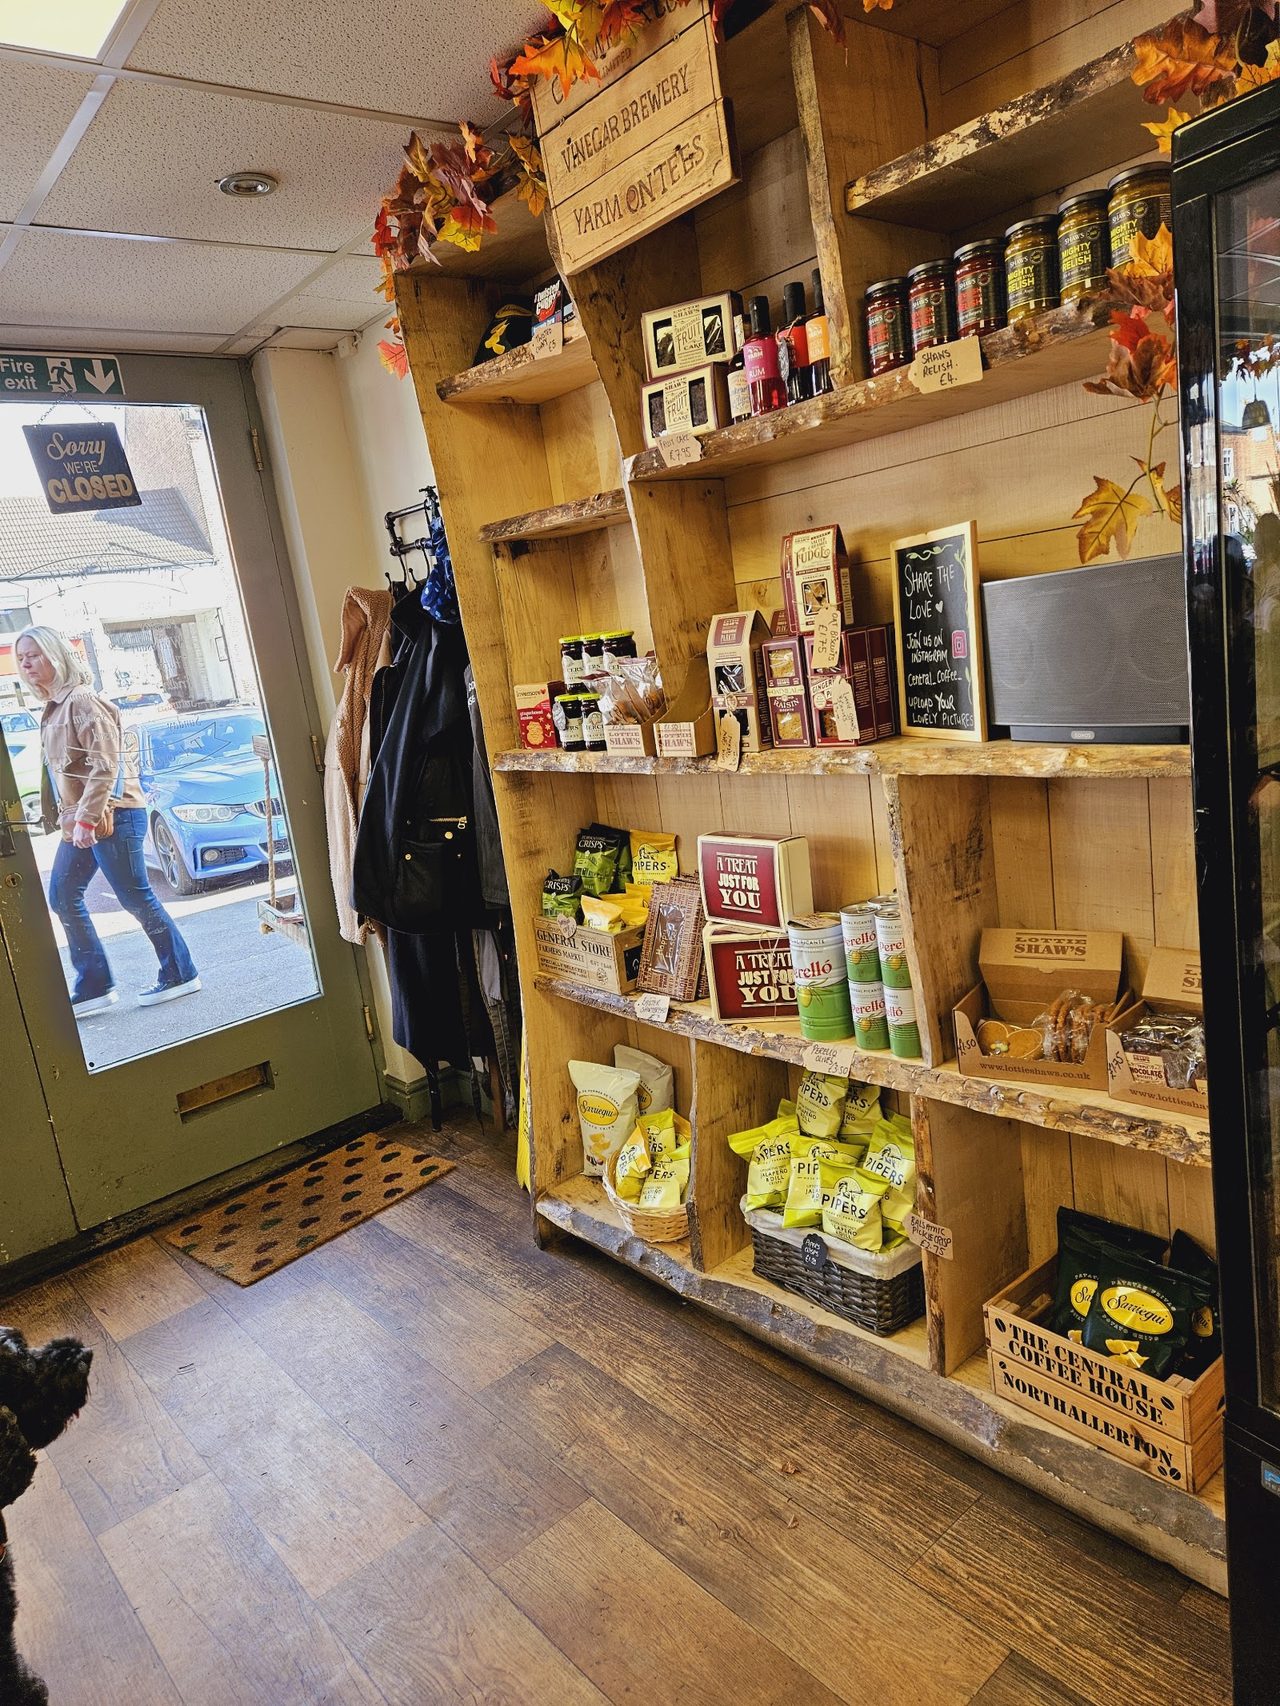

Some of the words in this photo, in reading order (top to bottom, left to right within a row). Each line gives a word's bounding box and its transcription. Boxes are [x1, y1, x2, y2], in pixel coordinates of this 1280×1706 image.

[561, 112, 622, 173] VINEGAR
[622, 63, 690, 134] BREWERY
[572, 194, 623, 235] YARM
[625, 173, 655, 214] ON
[655, 135, 704, 195] TEES
[1110, 219, 1137, 237] MIGHTY
[1062, 242, 1091, 259] MIGHTY
[1062, 254, 1092, 272] RELISH
[1007, 266, 1034, 280] MIGHTY
[1008, 277, 1035, 293] RELISH
[673, 309, 700, 319] SHAW'S
[675, 321, 702, 352] FRUIT
[684, 342, 703, 351] CAKE
[0, 358, 35, 374] Fire
[749, 368, 765, 377] RUM
[5, 376, 38, 390] exit
[666, 394, 688, 423] FRUIT
[47, 432, 107, 465] Sorry
[659, 439, 675, 451] FRUIT
[63, 460, 100, 474] WE'RE
[47, 474, 133, 503] CLOSED
[794, 546, 830, 570] FUDGE
[904, 564, 933, 598] SHARE
[937, 564, 954, 591] THE
[909, 600, 932, 619] LOVE
[828, 612, 838, 627] OAT
[934, 628, 943, 646] ON
[911, 650, 950, 670] INSTAGRAM
[773, 699, 800, 709] RAISIN
[909, 696, 934, 713] UPLOAD
[935, 692, 955, 711] YOUR
[913, 712, 938, 725] LOVELY
[942, 711, 974, 729] PICTURES
[609, 738, 641, 746] SHAW'S
[578, 840, 605, 849] CRISPS
[633, 861, 667, 871] PIPERS
[716, 857, 724, 870] A
[725, 858, 758, 875] TREAT
[544, 880, 571, 891] CRISPS
[718, 873, 741, 888] JUST
[741, 874, 760, 892] FOR
[719, 889, 761, 909] YOU
[537, 930, 579, 950] GENERAL
[581, 941, 613, 960] STORE
[880, 938, 905, 952] Perel
[1015, 936, 1087, 945] LOTTIE
[1014, 944, 1087, 956] SHAW'S
[736, 955, 747, 970] A
[748, 954, 792, 969] TREAT
[738, 971, 770, 986] JUST
[772, 968, 795, 985] FOR
[739, 984, 797, 1004] YOU
[811, 1044, 838, 1057] PERELLO
[979, 1062, 1091, 1081] www.lottieshaws.co.uk
[799, 1082, 830, 1107] PIPERS
[1129, 1088, 1208, 1110] www.lottiesha
[756, 1141, 791, 1165] PIPERS
[646, 1169, 675, 1180] PERS
[797, 1162, 819, 1175] PIP
[821, 1193, 866, 1219] PIPERS
[1106, 1295, 1169, 1326] Sarriegui
[1008, 1323, 1050, 1352] THE
[1054, 1338, 1154, 1402] CENTRAL
[1008, 1340, 1082, 1388] COFFEE
[1089, 1377, 1164, 1427] HOUSE
[1002, 1371, 1173, 1468] NORTHALLERTON
